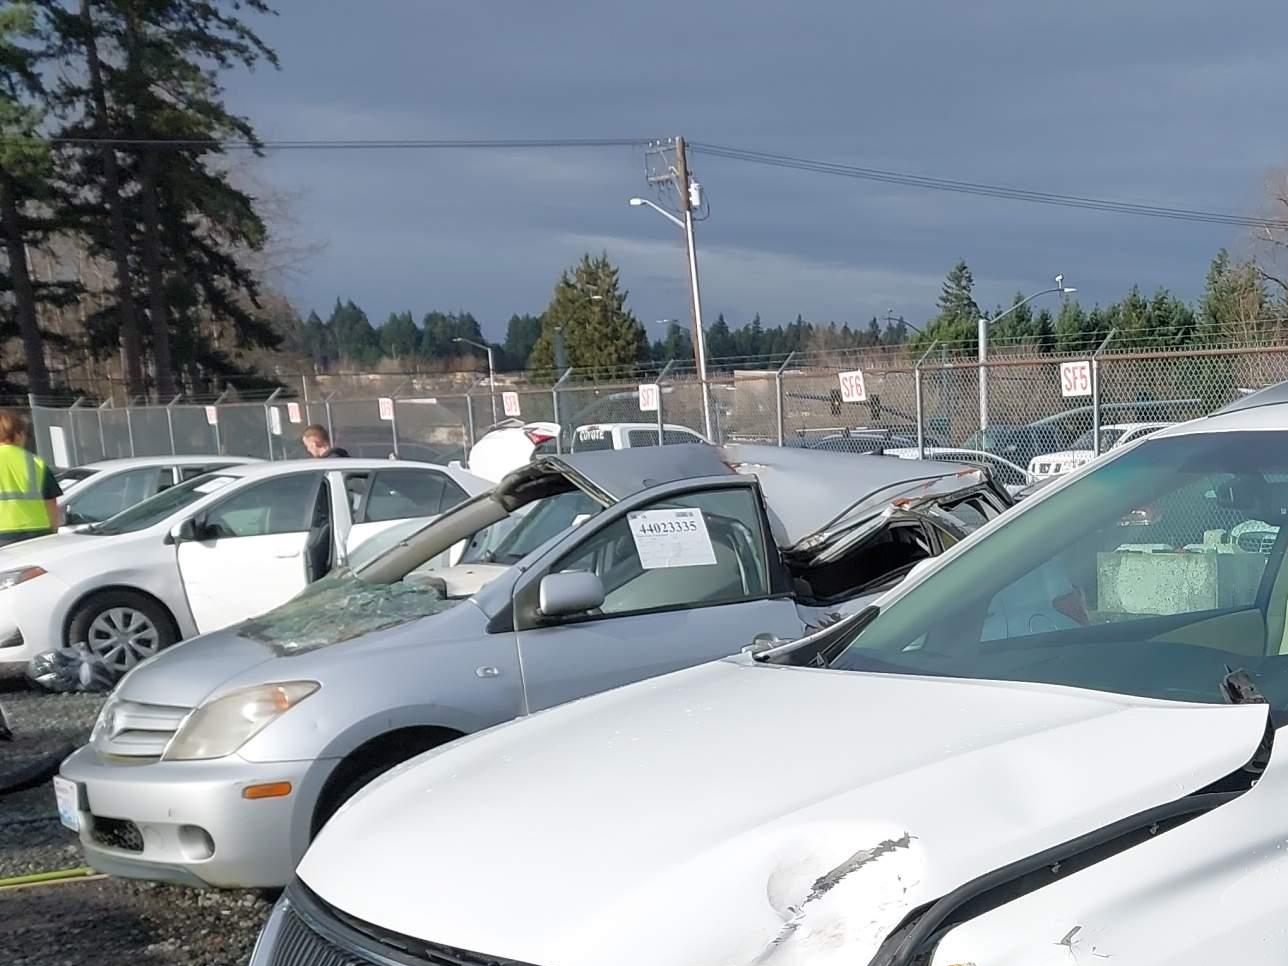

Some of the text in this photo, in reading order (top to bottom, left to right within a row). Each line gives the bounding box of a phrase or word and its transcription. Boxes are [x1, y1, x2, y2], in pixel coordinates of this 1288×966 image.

[842, 375, 862, 398] SF6
[1063, 366, 1088, 391] SF5
[640, 521, 697, 534] 44023335
